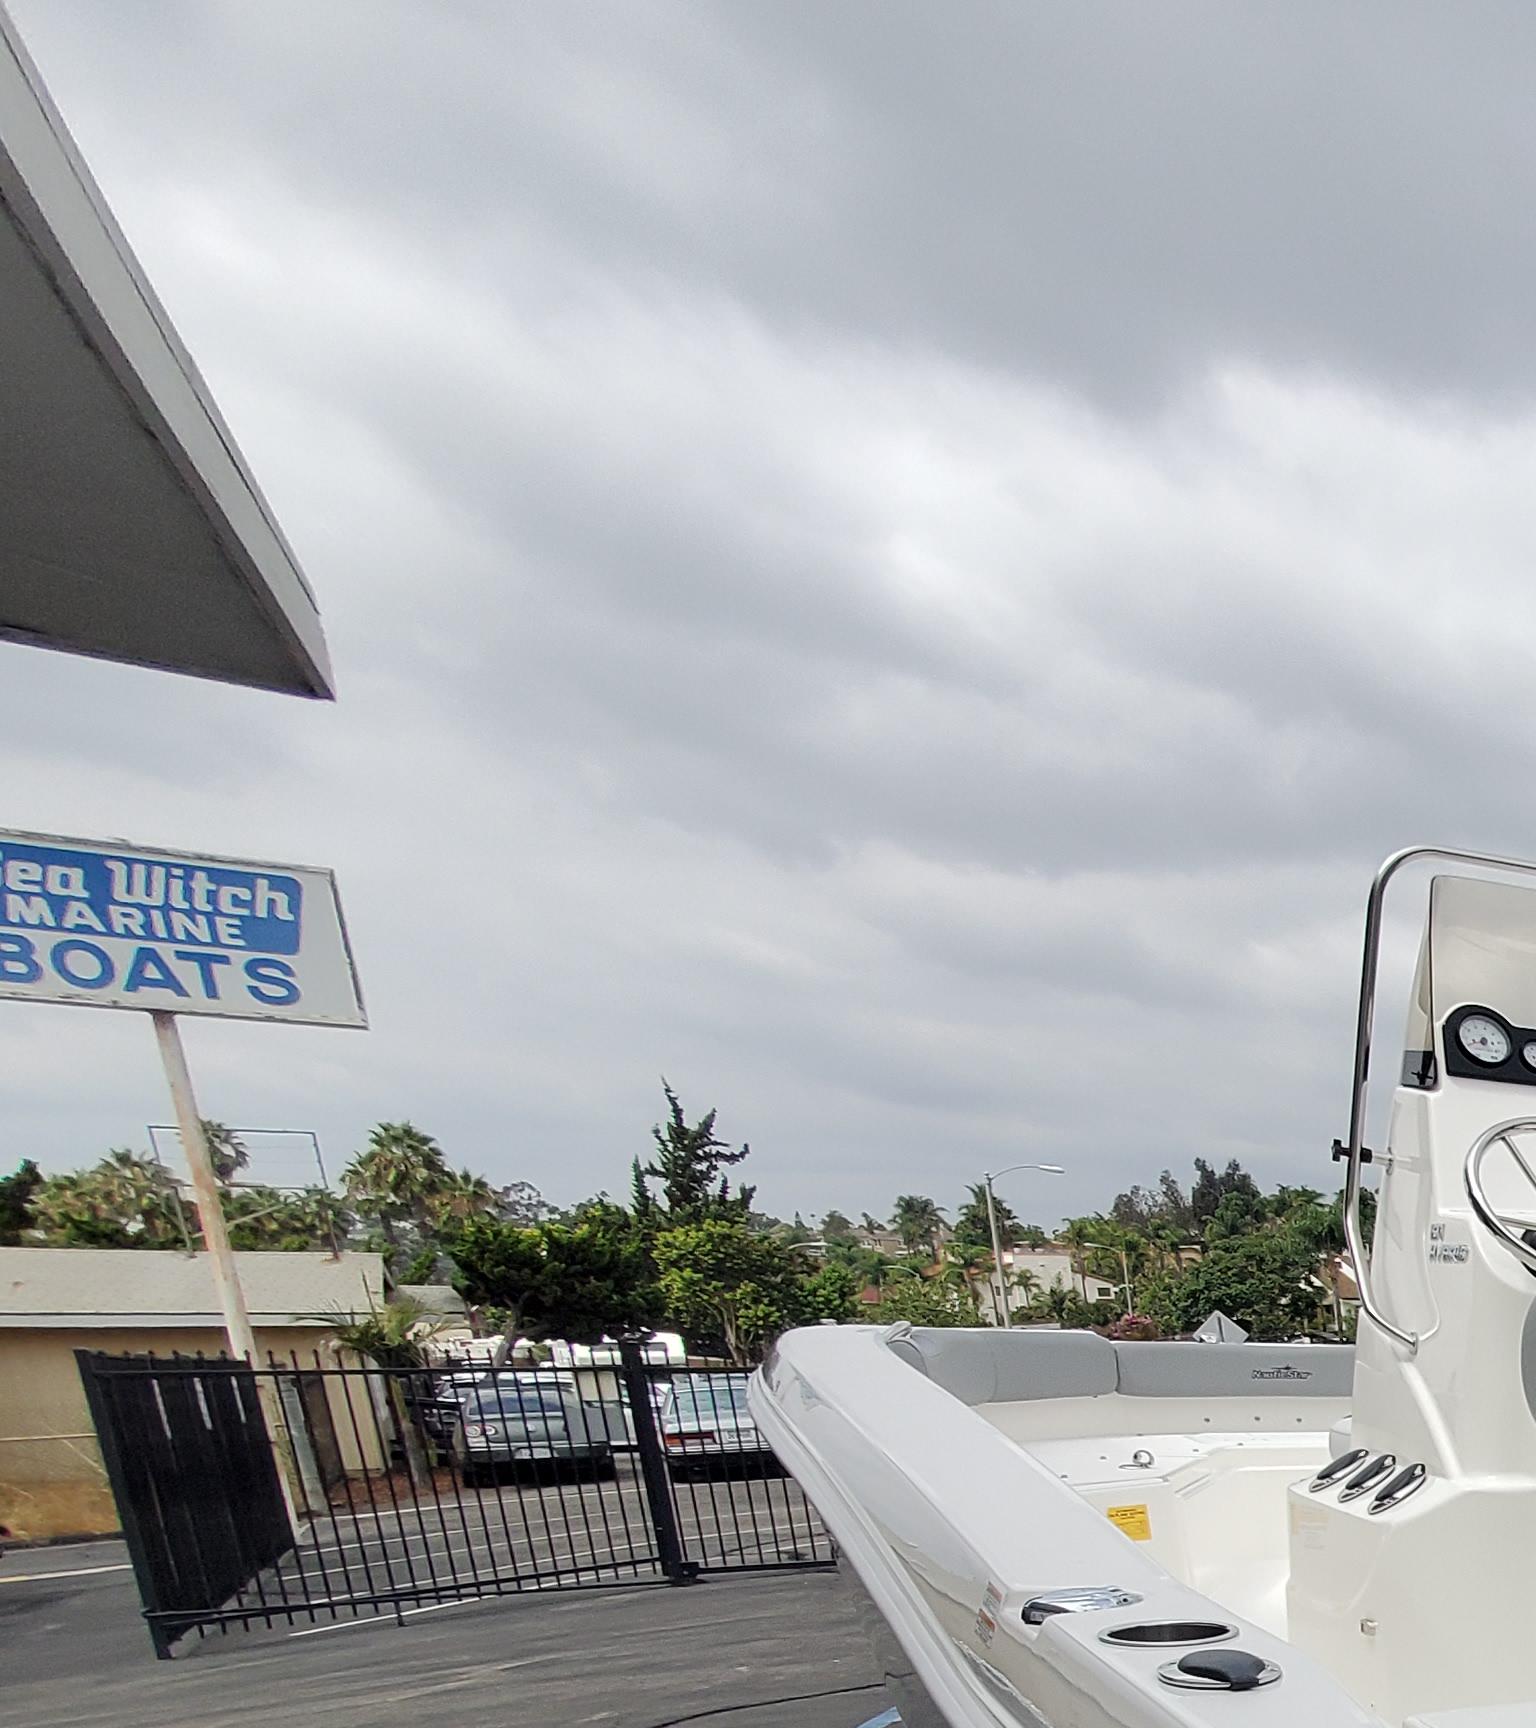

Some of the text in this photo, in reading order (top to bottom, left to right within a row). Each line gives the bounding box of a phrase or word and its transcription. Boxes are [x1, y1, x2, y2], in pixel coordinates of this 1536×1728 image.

[0, 850, 295, 921] ea Witch
[5, 893, 248, 947] MARINE
[0, 932, 302, 1006] BOATS
